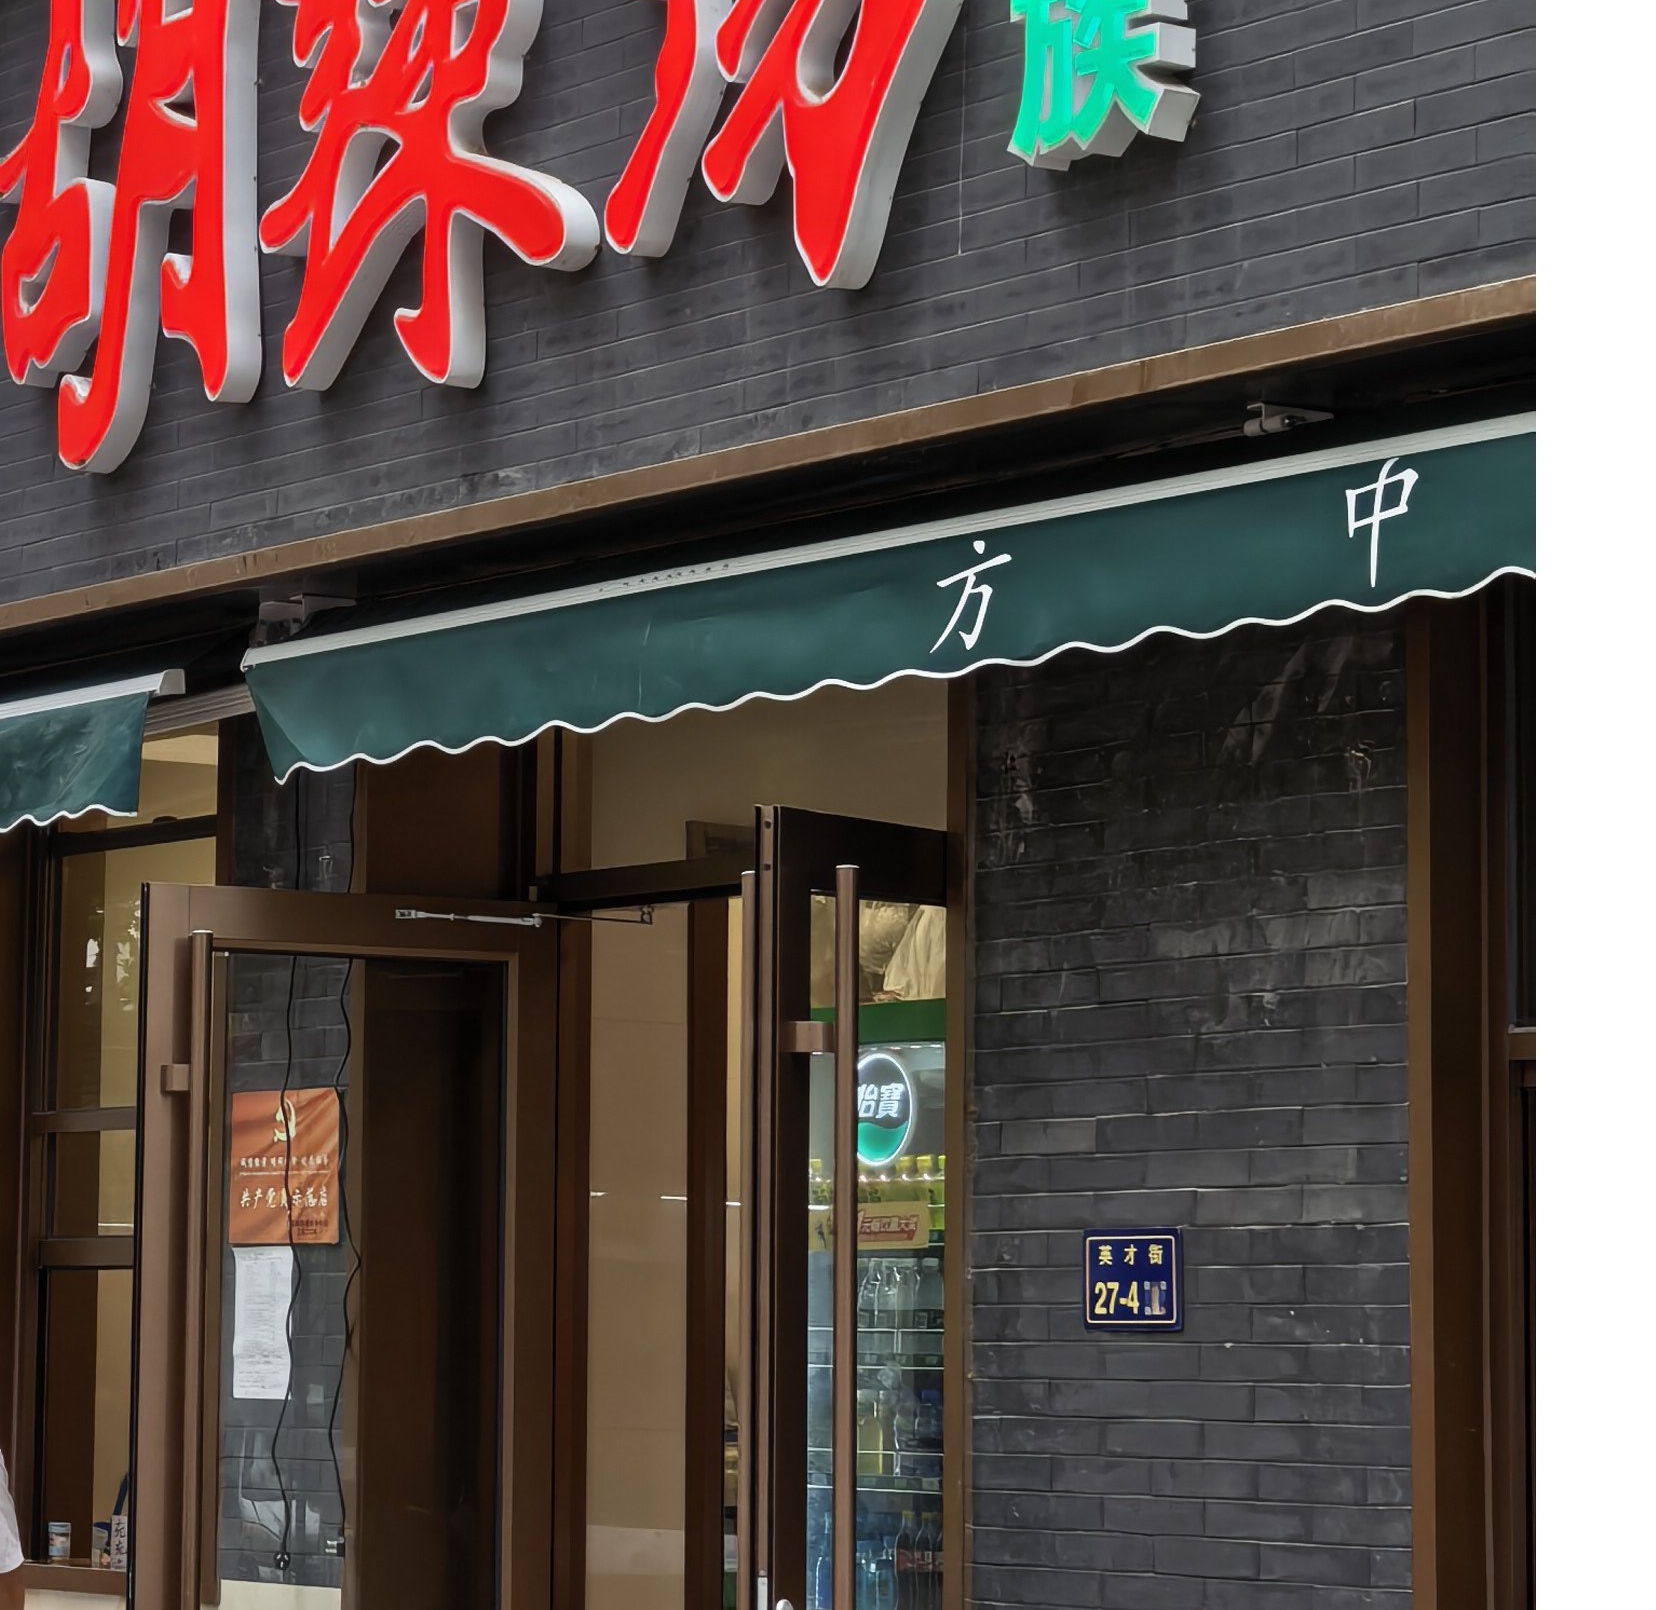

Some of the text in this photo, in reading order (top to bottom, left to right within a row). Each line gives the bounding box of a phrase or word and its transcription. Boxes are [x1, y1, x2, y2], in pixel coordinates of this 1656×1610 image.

[1098, 1244, 1163, 1266] 英才街
[1094, 1281, 1140, 1315] 27-4
